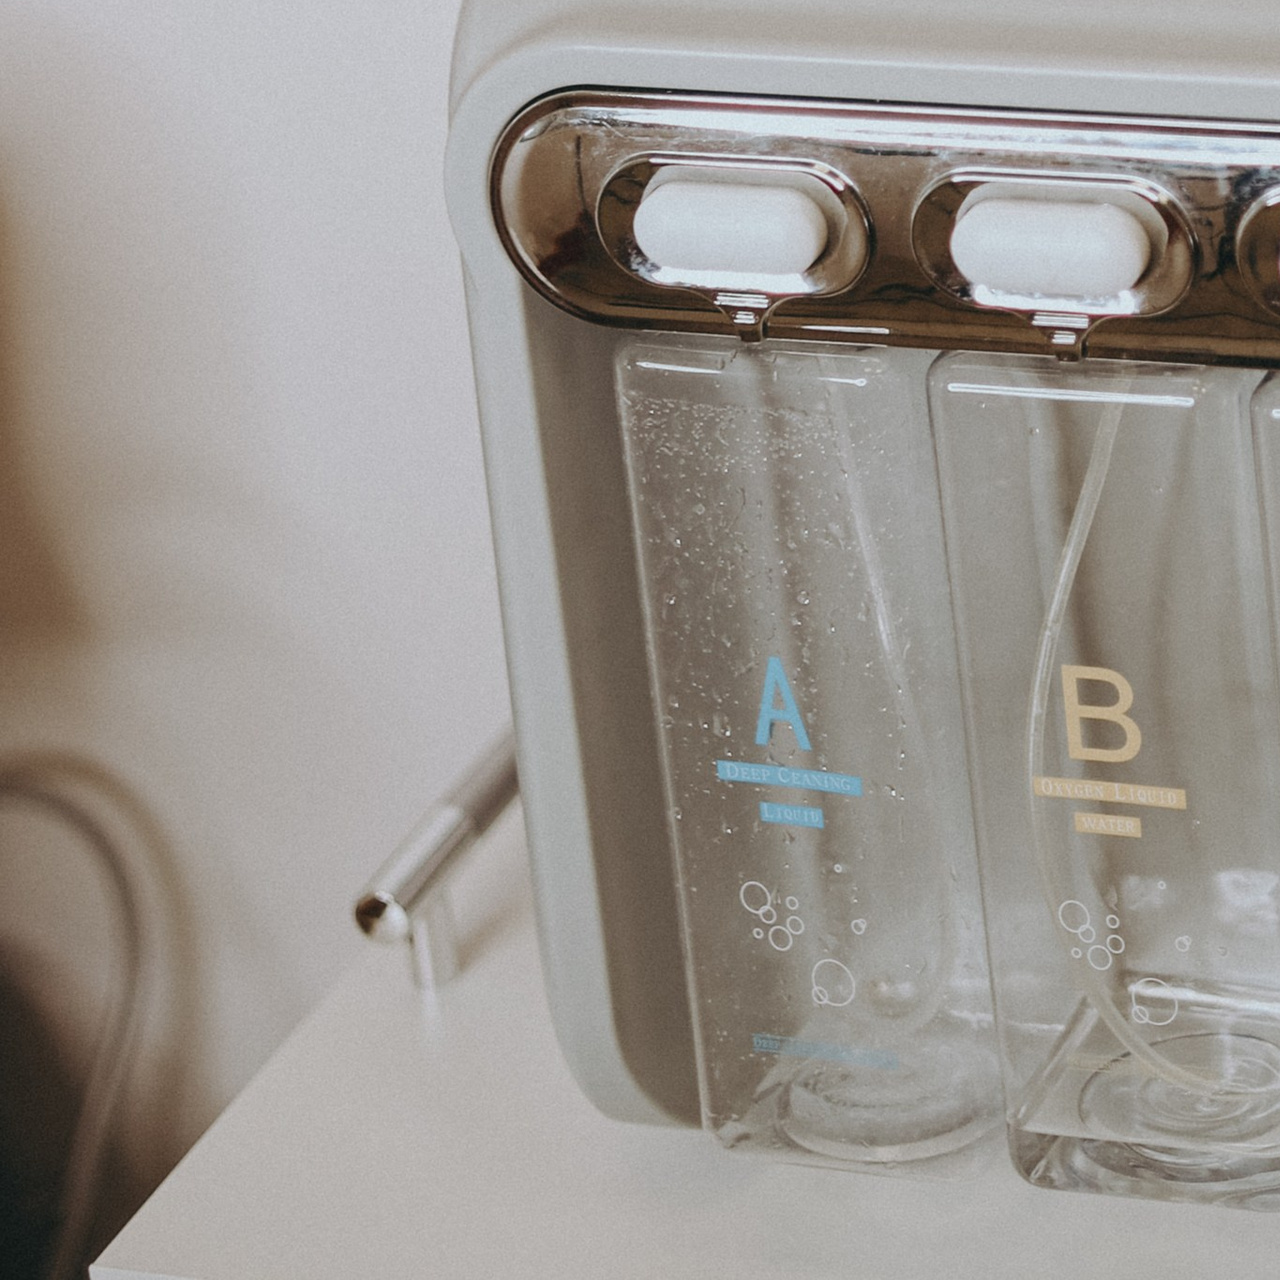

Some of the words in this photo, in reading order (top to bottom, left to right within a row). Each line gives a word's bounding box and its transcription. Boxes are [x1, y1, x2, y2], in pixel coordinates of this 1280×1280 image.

[754, 656, 813, 751] A
[1061, 663, 1142, 763] B
[724, 762, 772, 781] DEEP
[1040, 777, 1104, 799] OXYGEN
[1113, 783, 1178, 806] LIQUID
[762, 802, 820, 824] LIQUID
[1081, 815, 1136, 834] WATER
